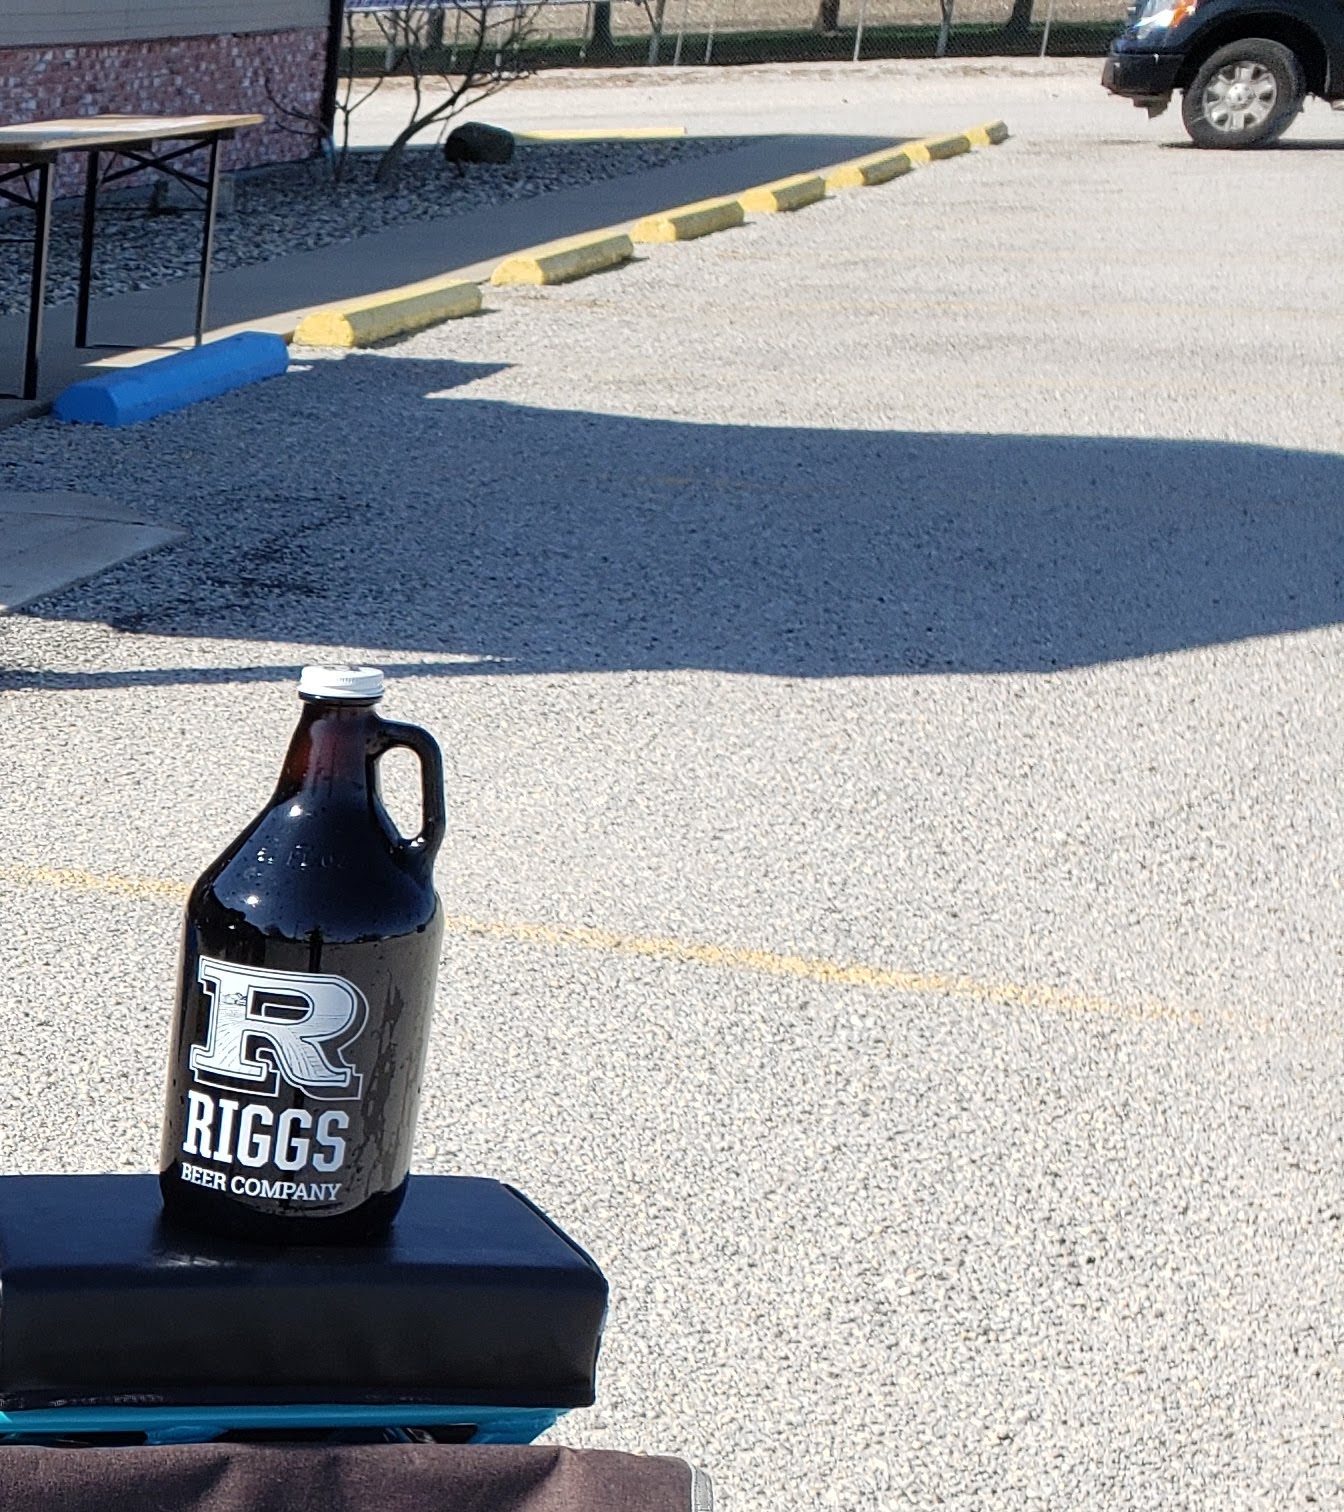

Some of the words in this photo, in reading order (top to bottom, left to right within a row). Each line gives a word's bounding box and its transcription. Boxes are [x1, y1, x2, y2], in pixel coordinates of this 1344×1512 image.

[189, 954, 370, 1099] R
[182, 1089, 349, 1172] RIGGS
[180, 1162, 227, 1193] BEER
[230, 1175, 342, 1201] COMPANY
